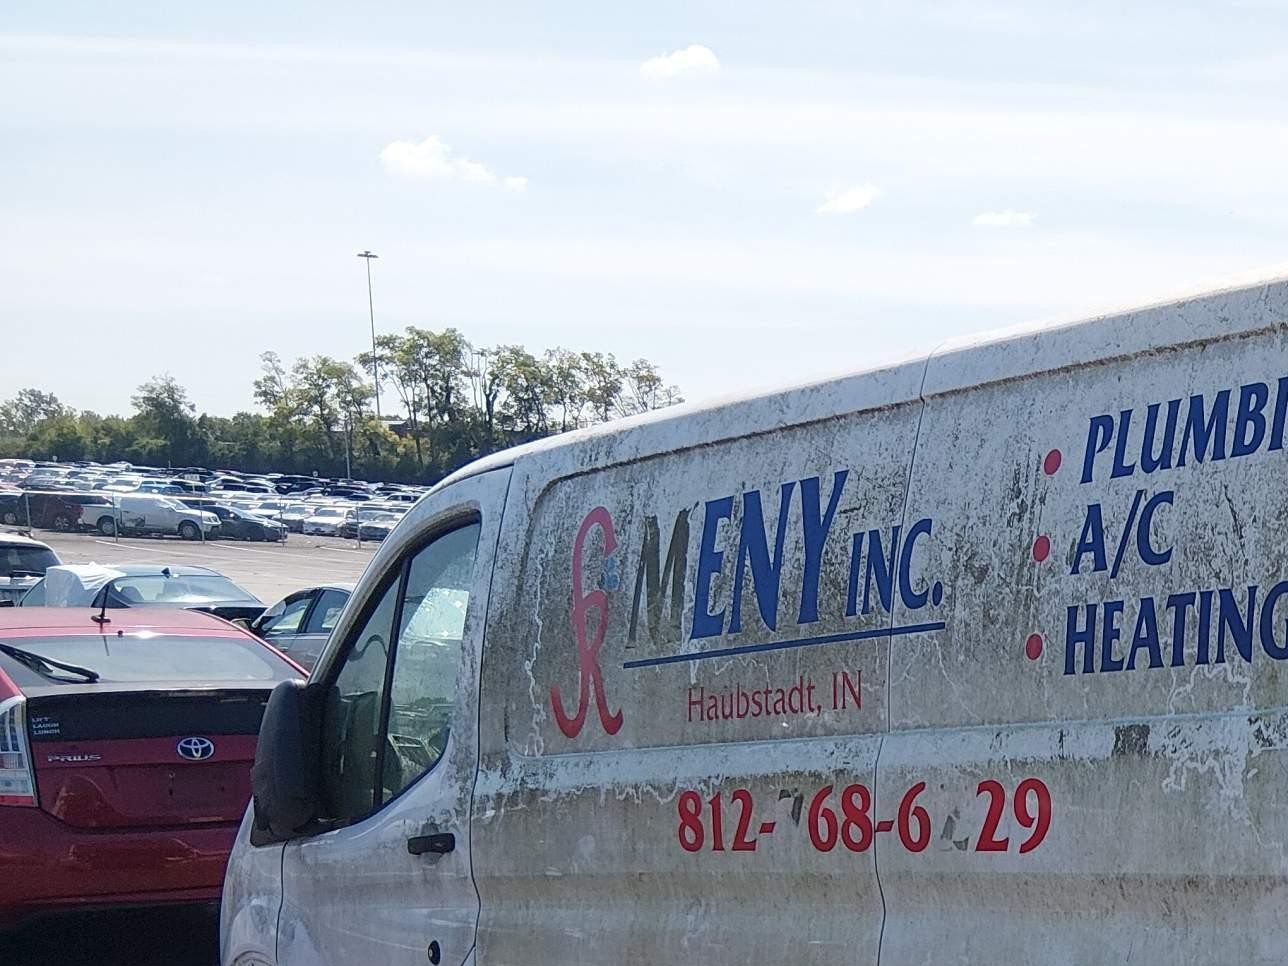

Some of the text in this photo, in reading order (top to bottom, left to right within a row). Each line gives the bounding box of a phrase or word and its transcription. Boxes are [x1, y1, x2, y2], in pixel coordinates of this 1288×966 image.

[845, 518, 943, 616] INC.
[1070, 489, 1174, 579] A/C
[687, 670, 862, 722] Haubstadt, IN
